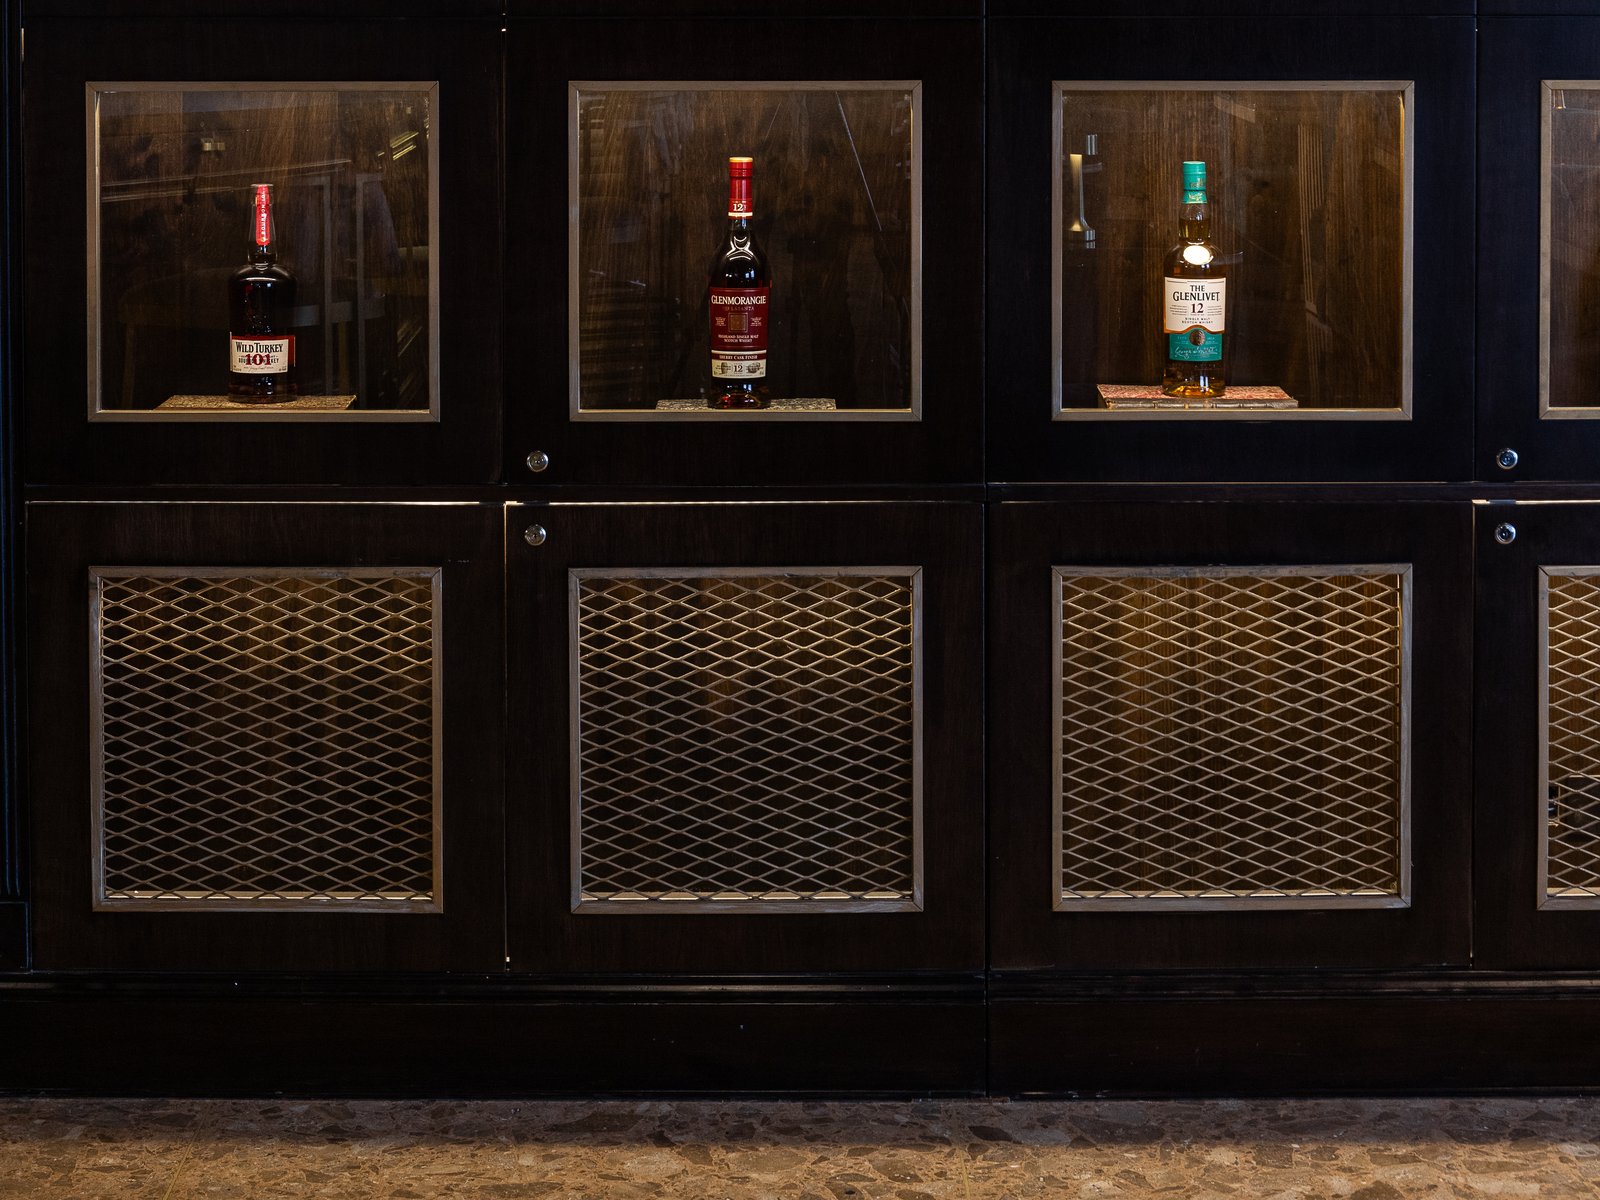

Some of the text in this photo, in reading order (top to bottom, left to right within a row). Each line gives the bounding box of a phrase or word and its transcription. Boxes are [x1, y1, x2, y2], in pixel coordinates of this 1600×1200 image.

[733, 203, 743, 211] 12
[711, 295, 766, 305] GLENMORANGIE
[1173, 291, 1220, 301] GLENLIVET
[1191, 303, 1204, 313] 12
[236, 342, 283, 353] WILD TURKEY
[246, 354, 271, 366] 101
[734, 364, 743, 373] 12
